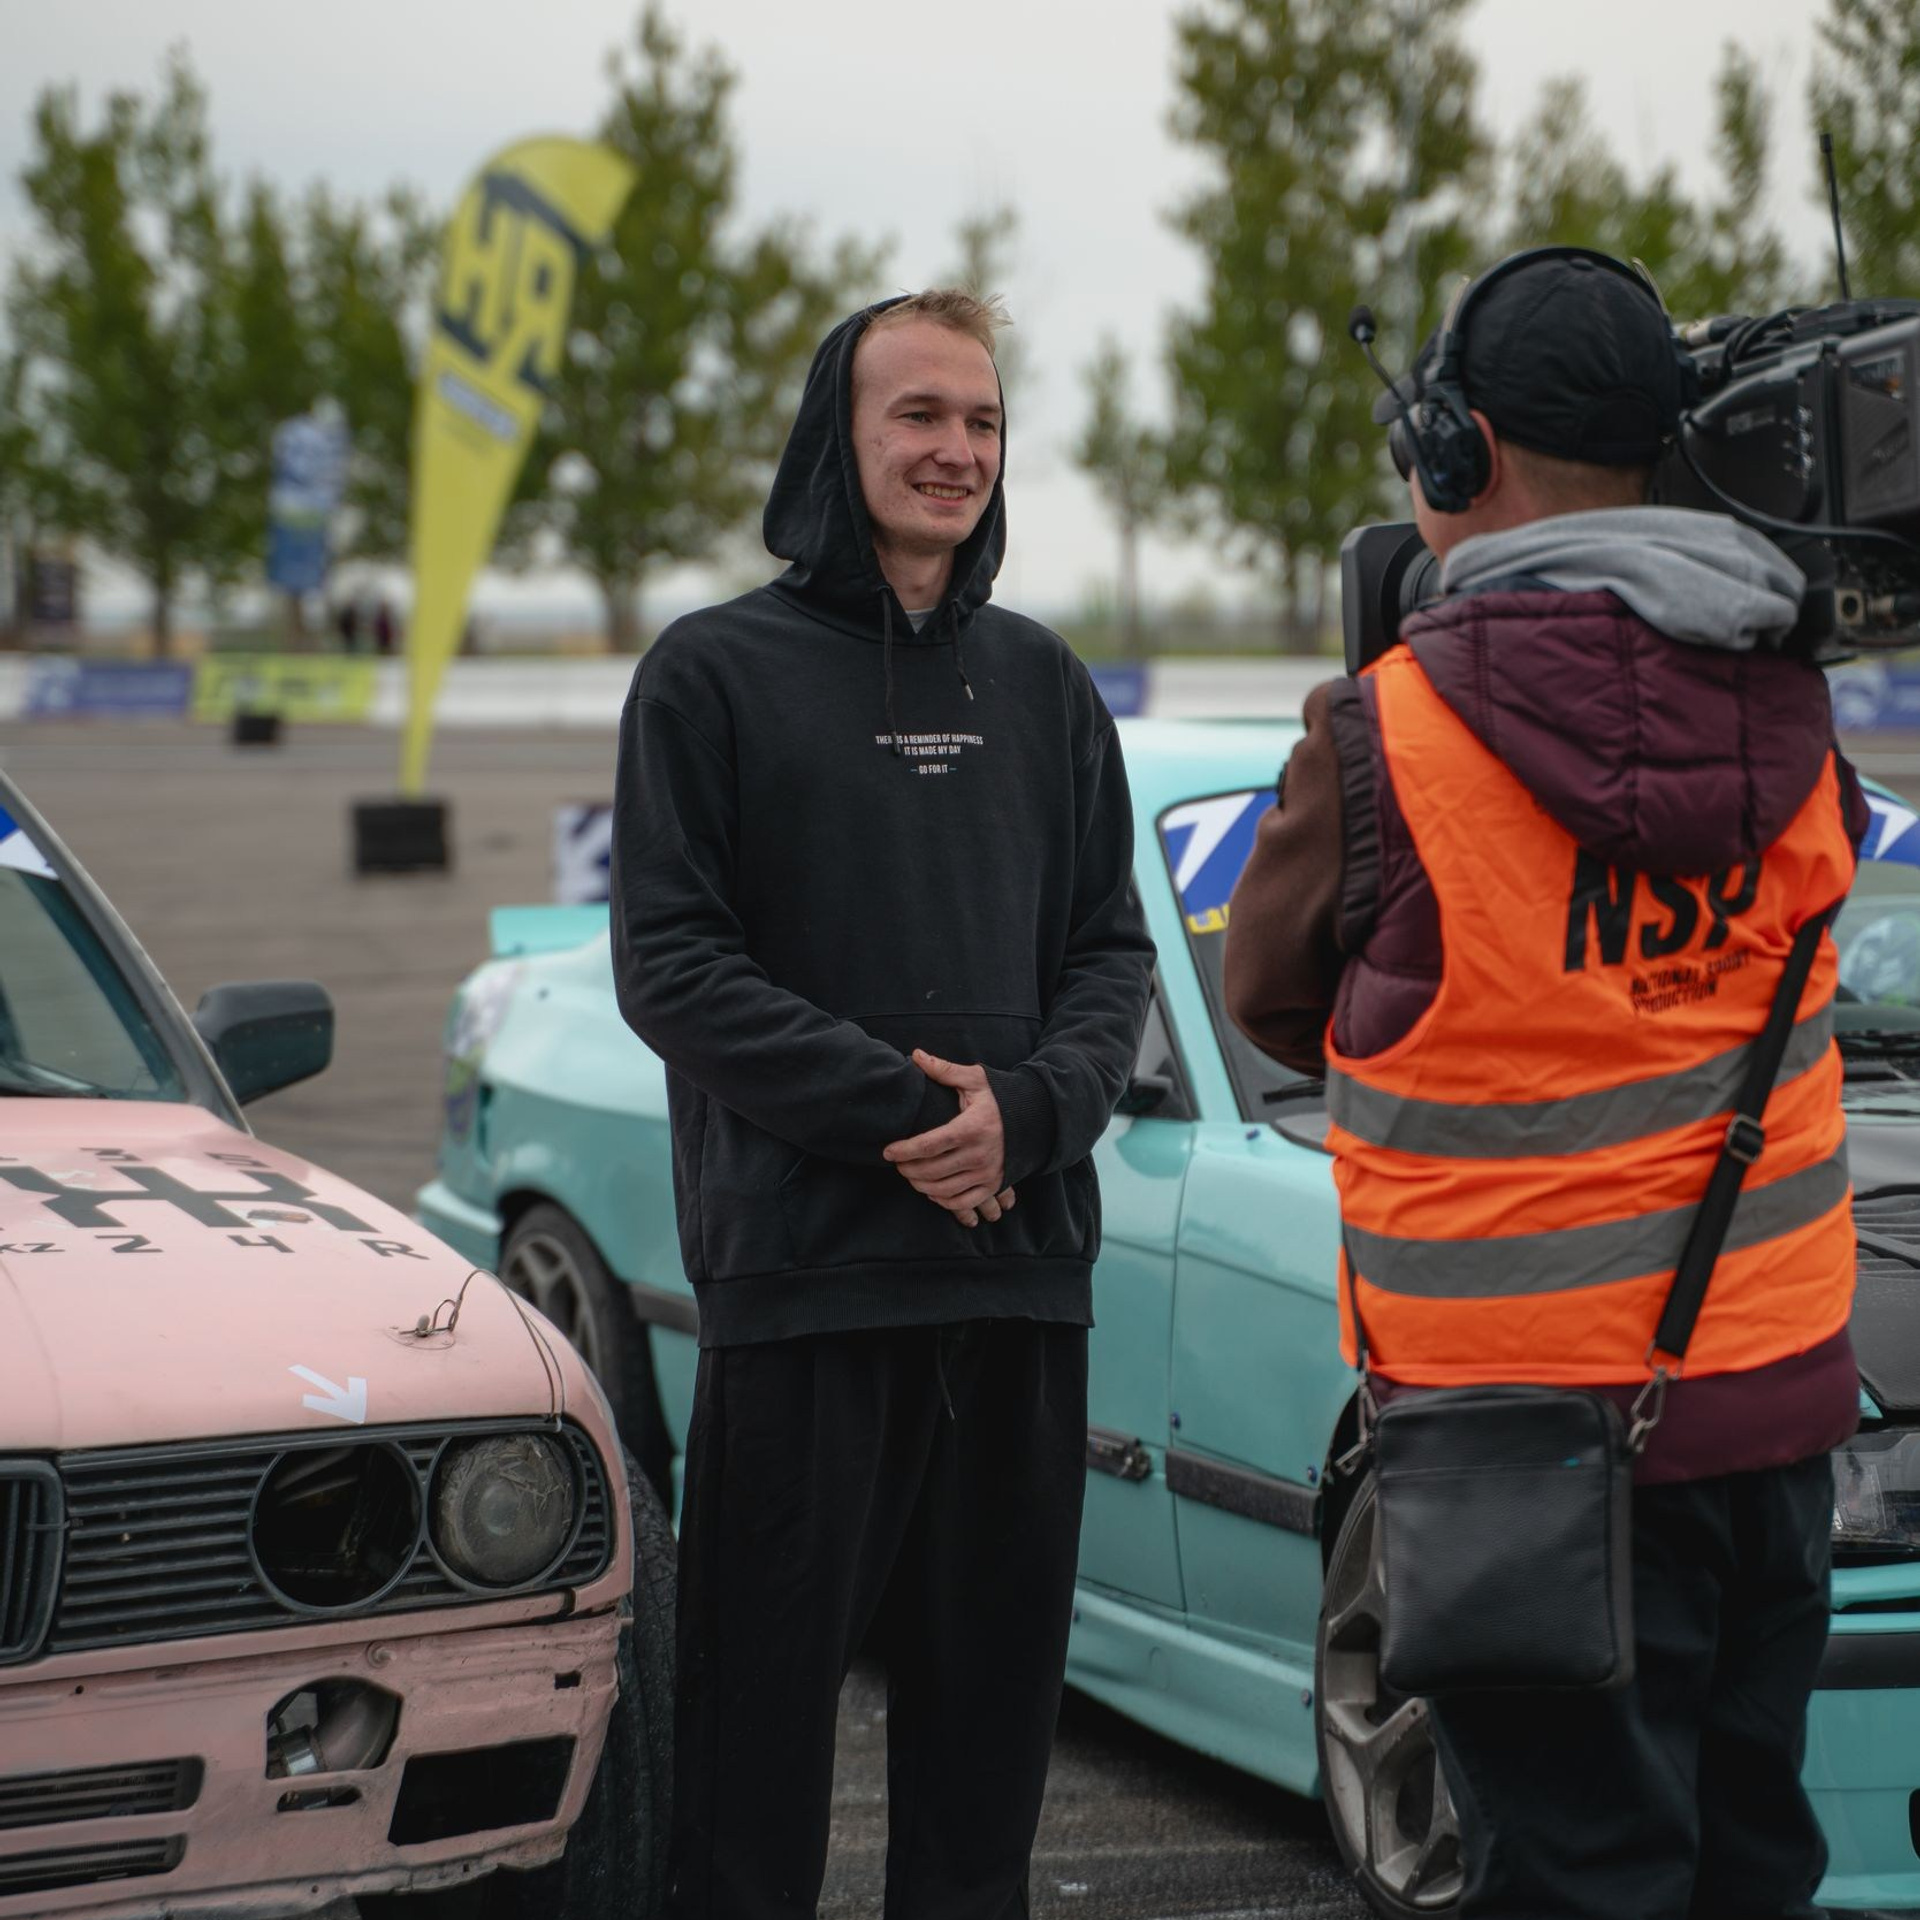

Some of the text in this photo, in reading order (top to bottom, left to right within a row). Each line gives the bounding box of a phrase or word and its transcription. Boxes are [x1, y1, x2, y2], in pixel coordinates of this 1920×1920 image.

[909, 734, 941, 744] REMINDER
[941, 733, 951, 743] OF
[951, 733, 984, 745] HAPPINESS
[904, 744, 961, 755] IT IS MADE MY DAY
[918, 764, 928, 774] GO
[928, 764, 941, 773] FOR
[227, 1234, 296, 1254] 4
[358, 1238, 431, 1260] R
